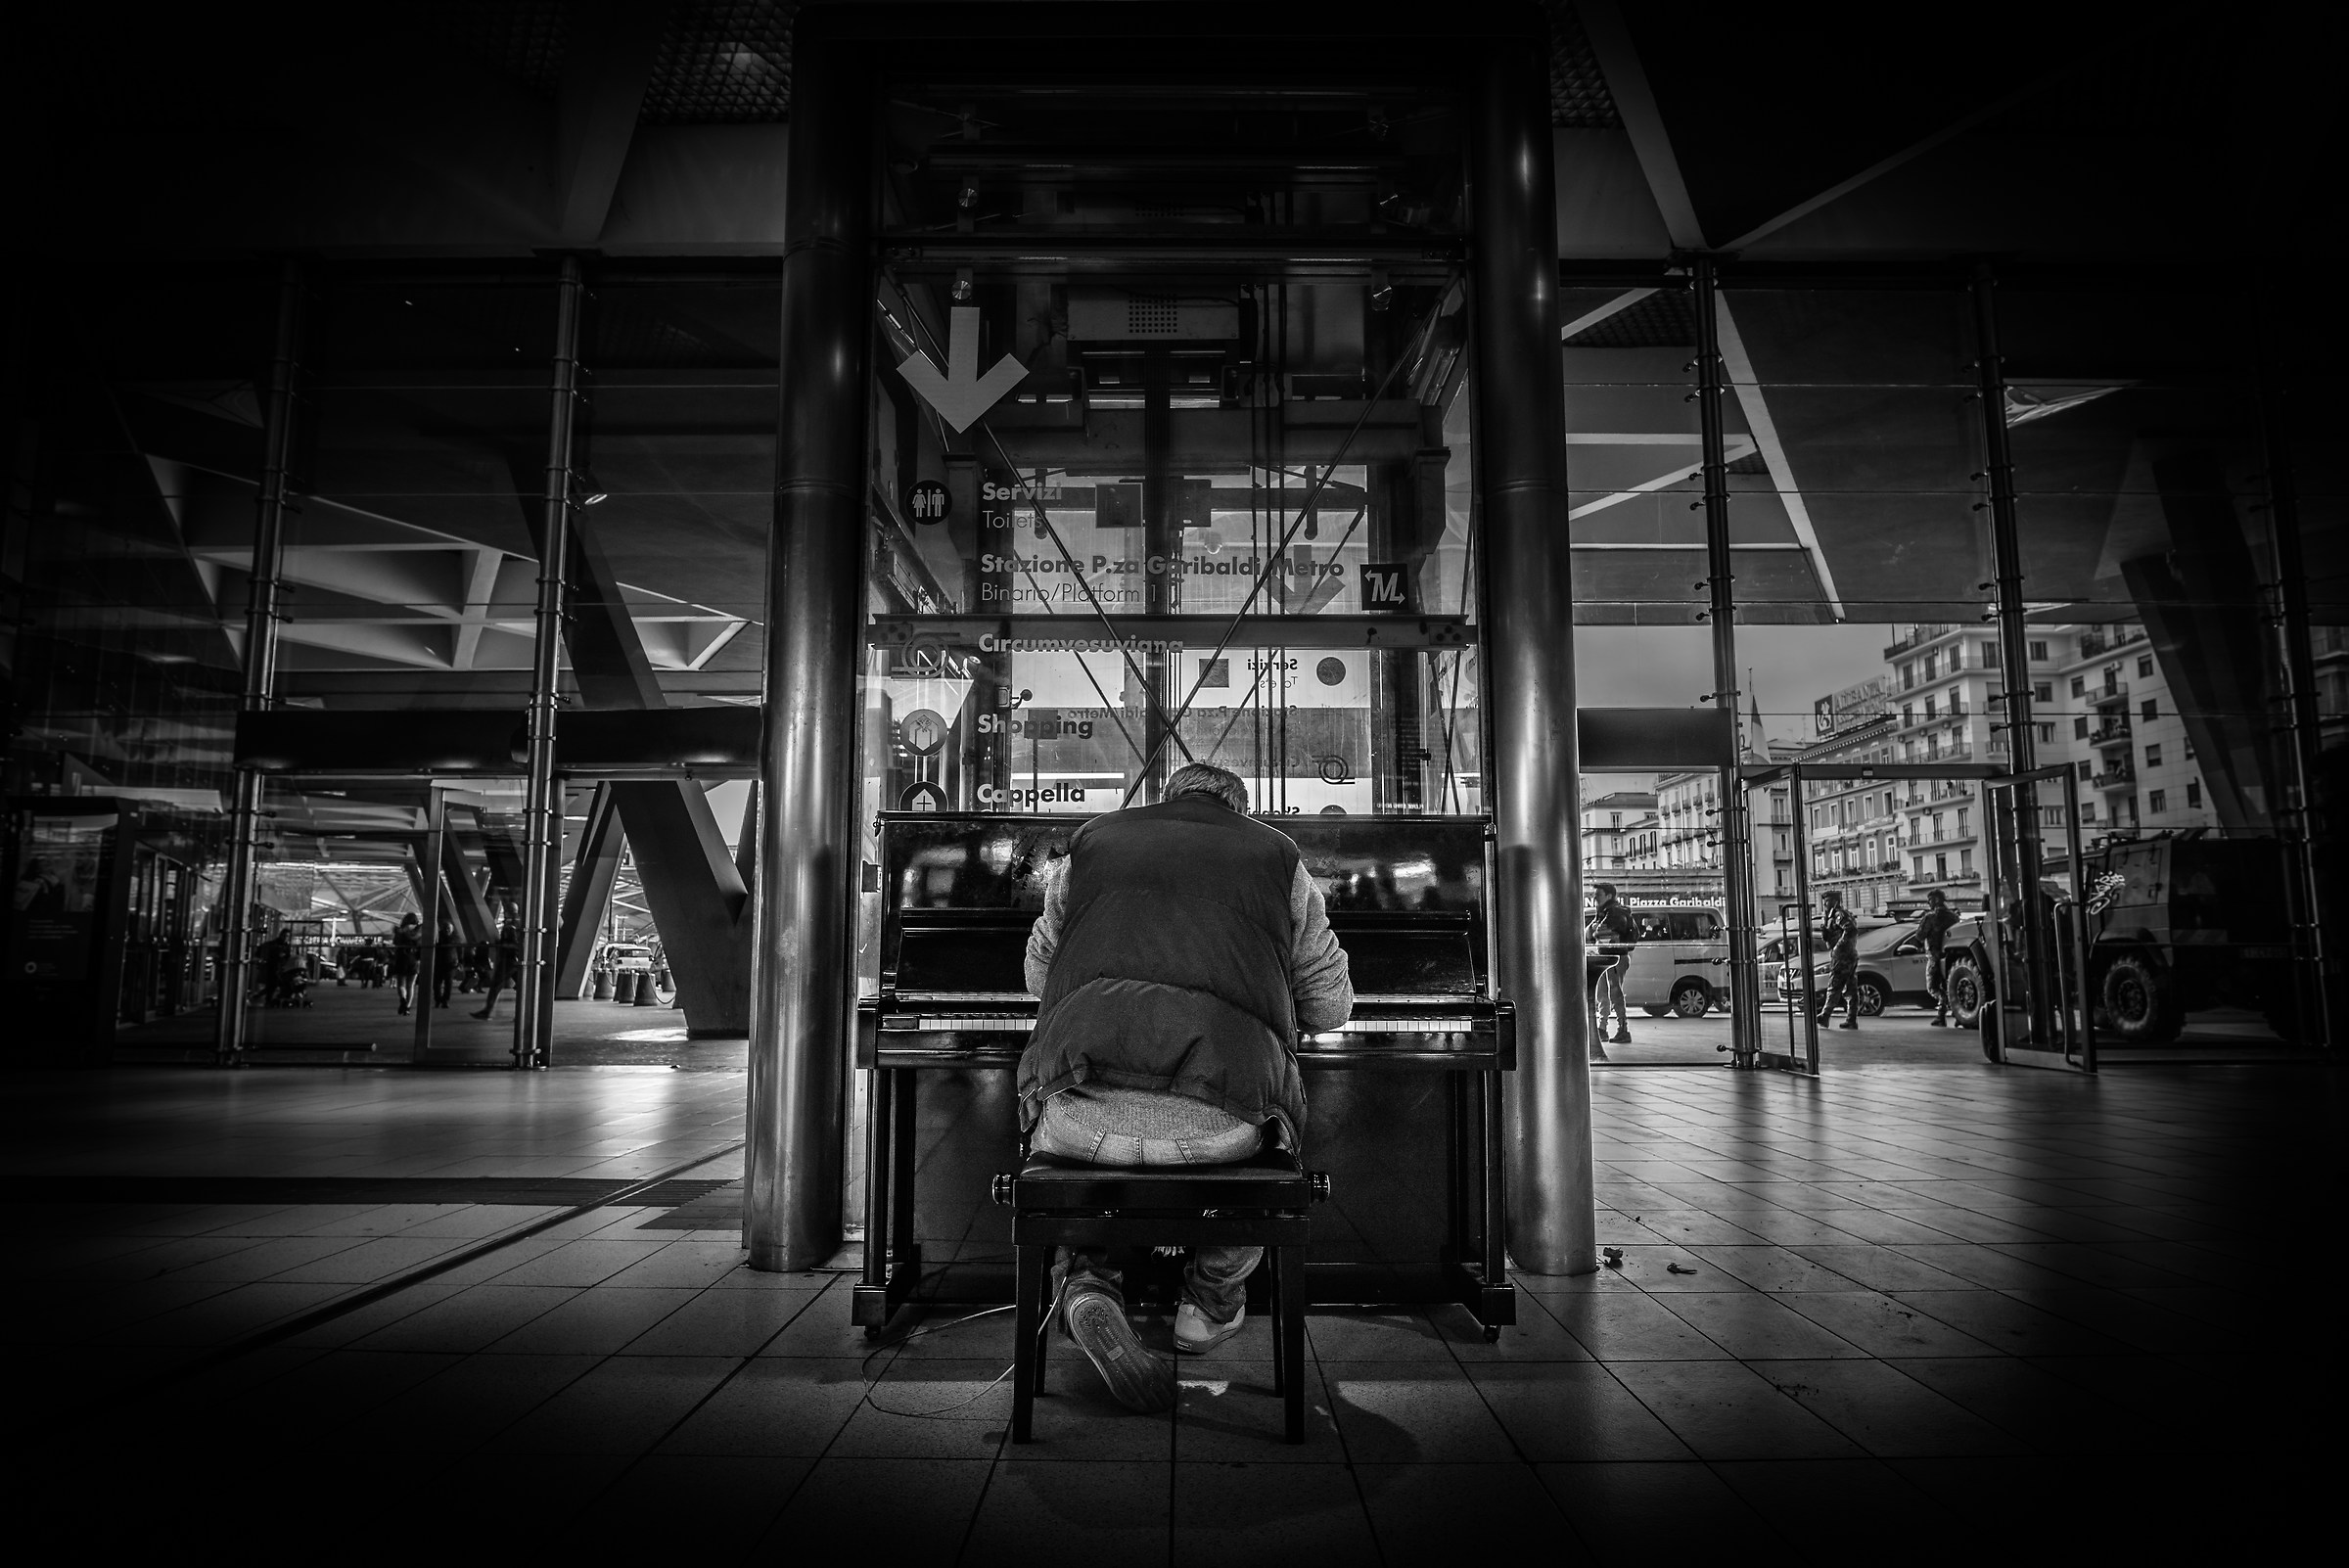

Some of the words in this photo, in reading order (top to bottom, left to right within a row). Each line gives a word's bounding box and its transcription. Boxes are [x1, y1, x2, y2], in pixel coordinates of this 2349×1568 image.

[982, 482, 1062, 500] Servizi
[982, 510, 1043, 529] Toilets
[981, 554, 1084, 574] Stazione
[1092, 555, 1139, 575] P.za
[979, 633, 1183, 653] Circumvesuviana
[978, 713, 1093, 739] Shopping
[977, 782, 1085, 807] Cappella
[1630, 897, 1667, 906] Piazza
[1670, 897, 1726, 907] Garibaldi
